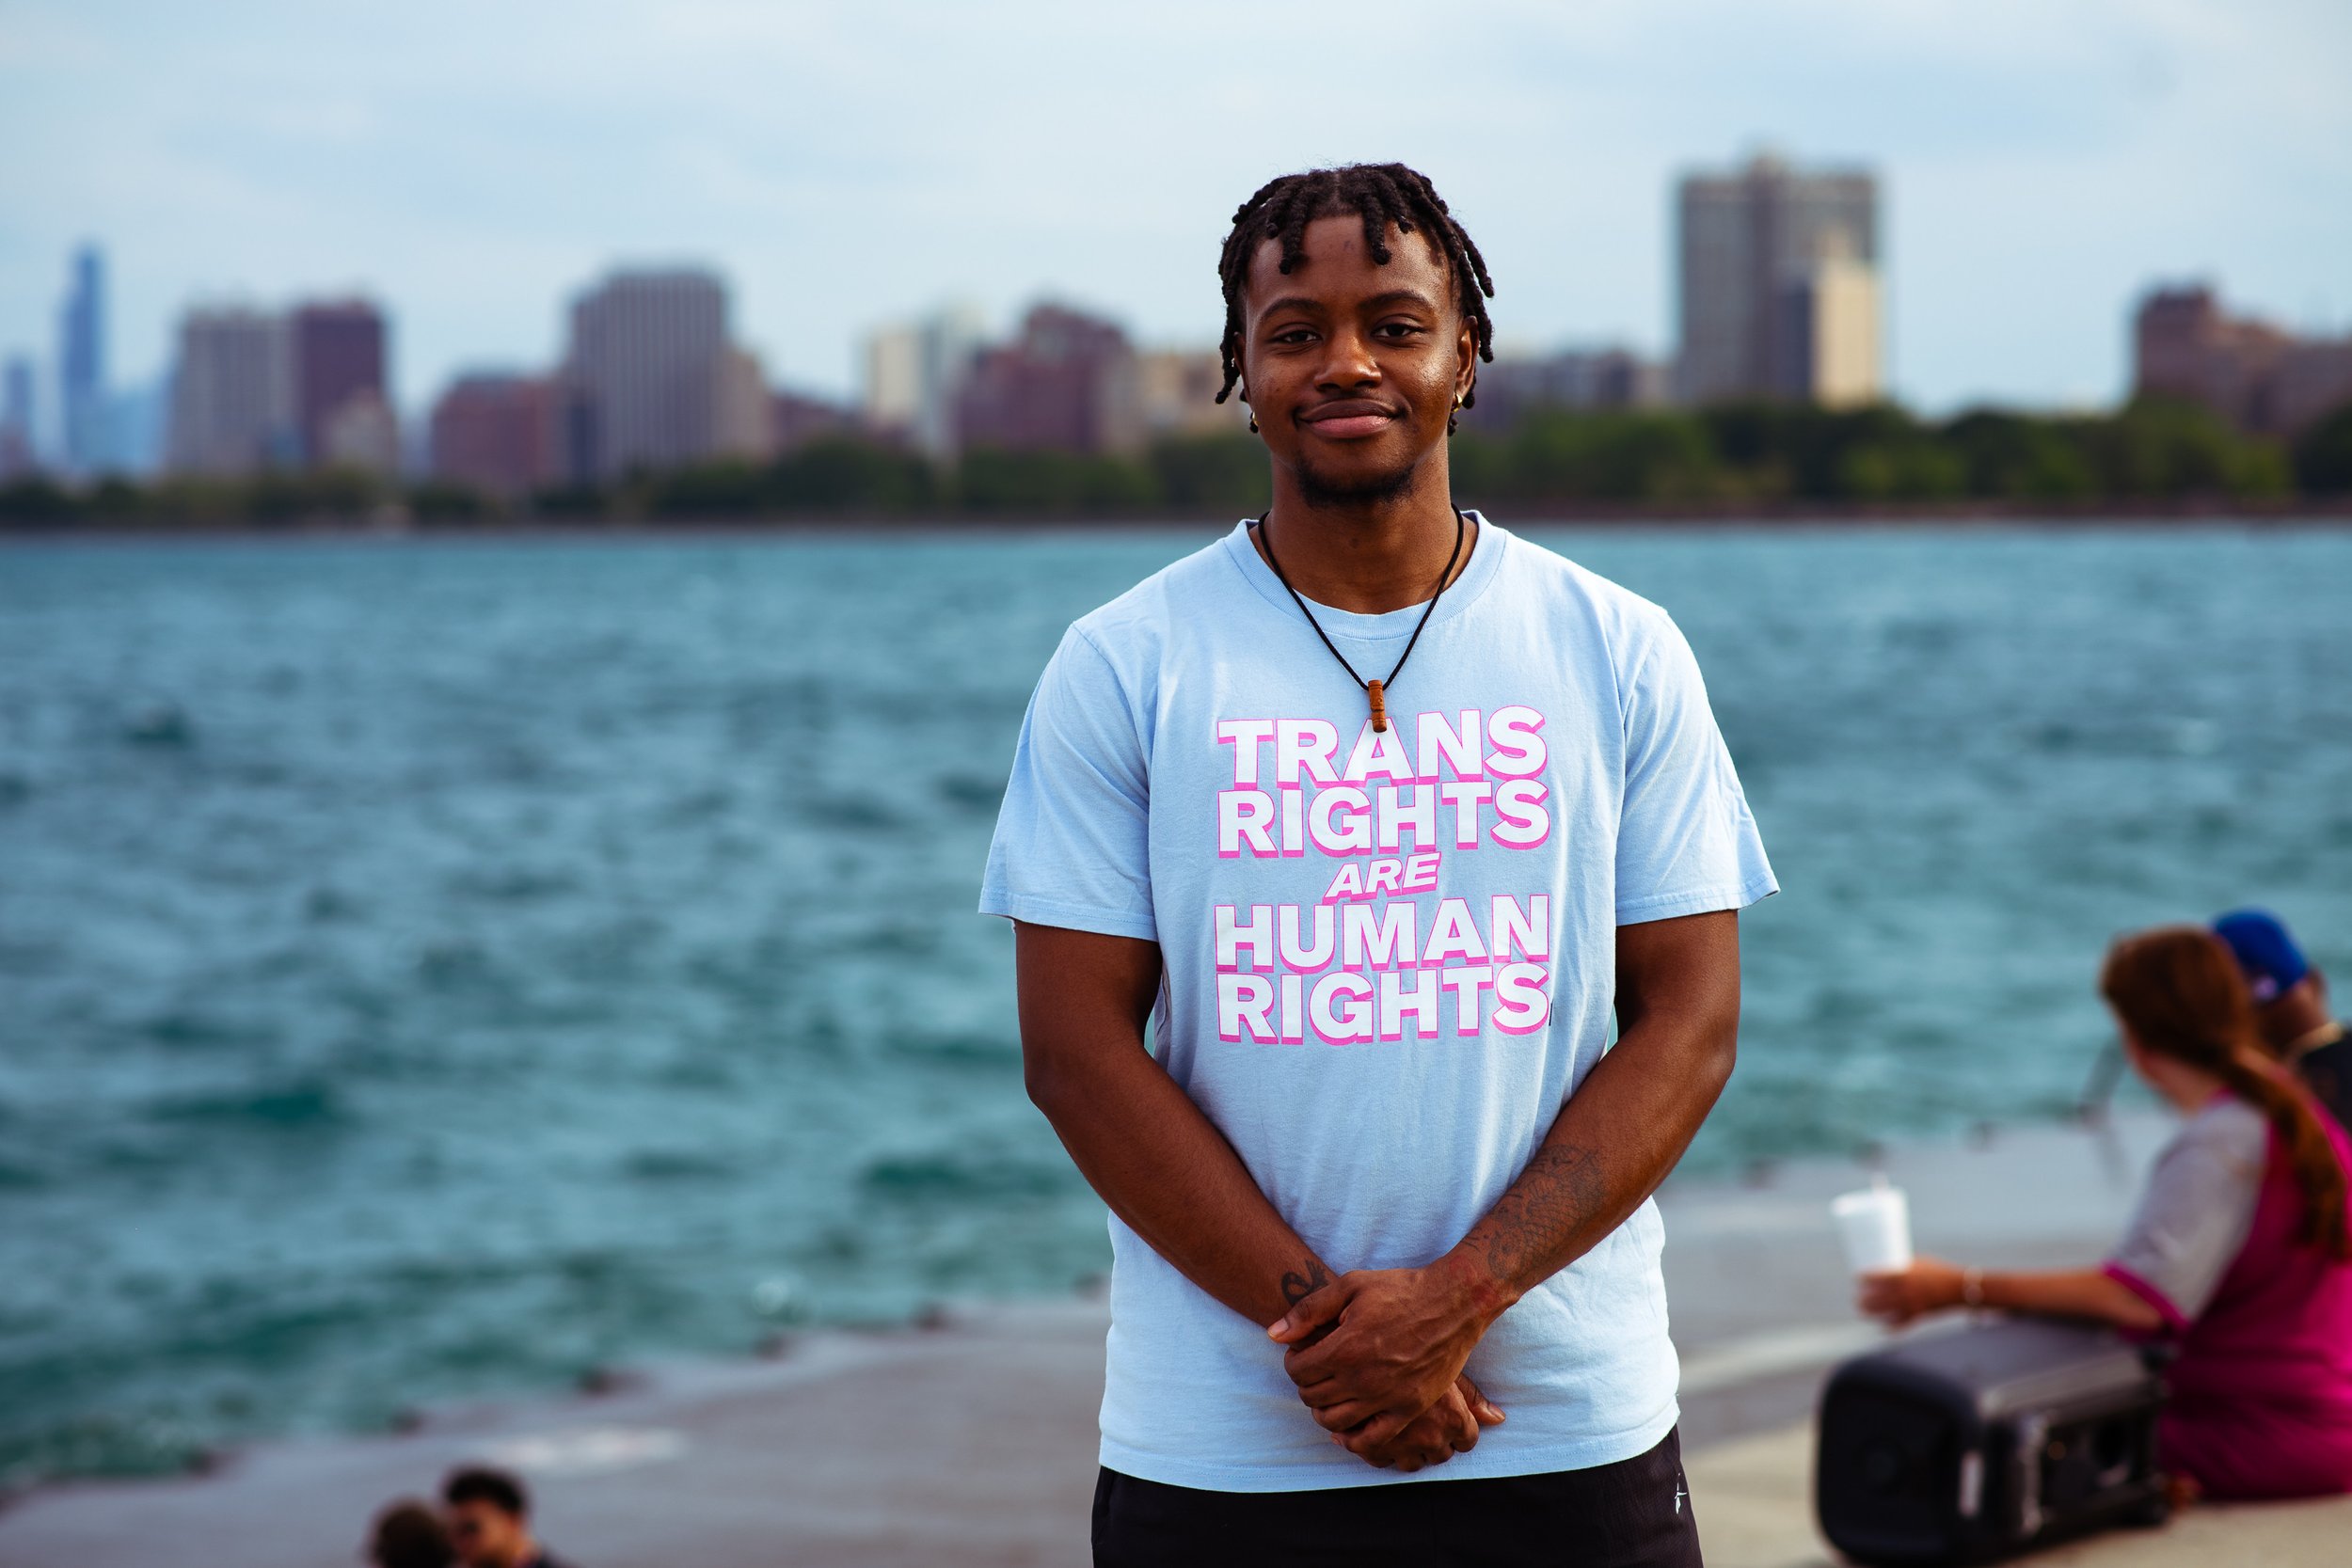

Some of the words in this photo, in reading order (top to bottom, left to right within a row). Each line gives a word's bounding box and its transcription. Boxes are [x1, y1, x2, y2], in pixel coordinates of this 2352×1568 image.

[1217, 705, 1549, 790] TRANS
[1217, 779, 1550, 859] RIGHTS
[1322, 851, 1442, 905] ARE
[1214, 894, 1550, 974] HUMAN
[1216, 961, 1550, 1047] RIGHTS
